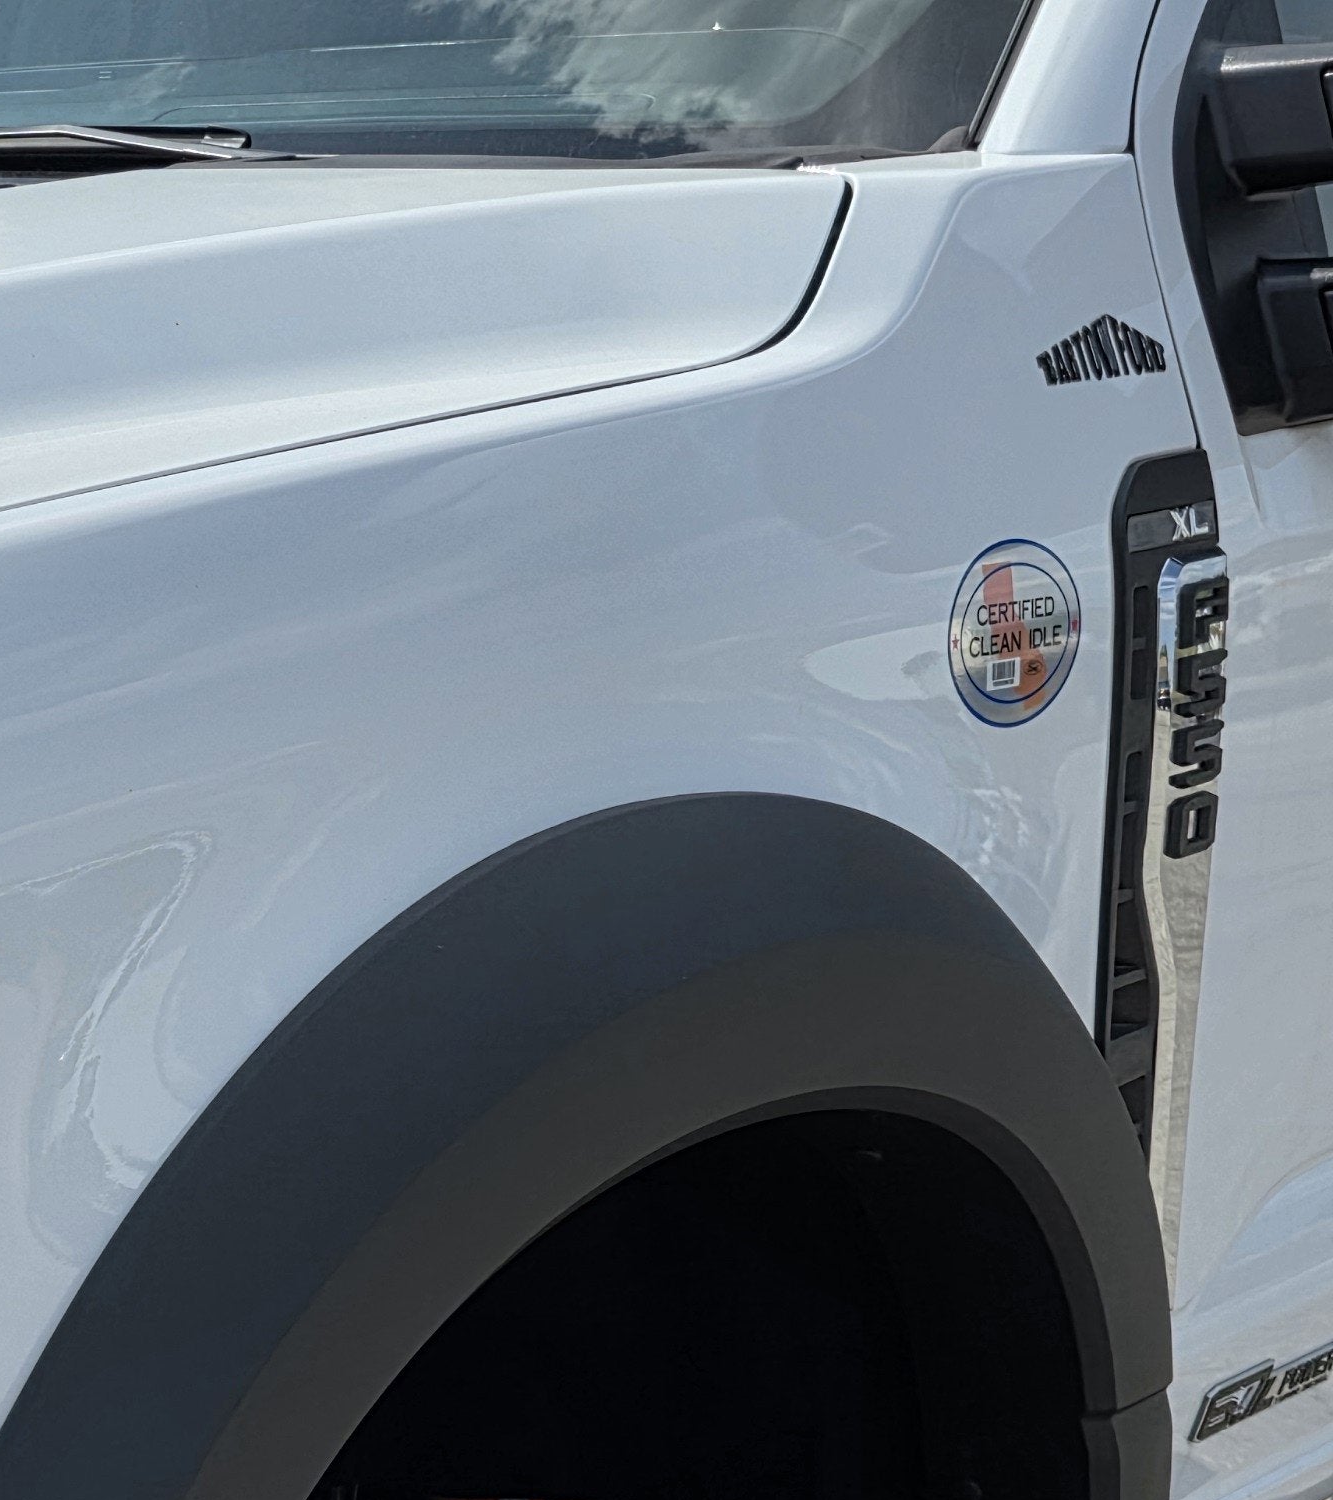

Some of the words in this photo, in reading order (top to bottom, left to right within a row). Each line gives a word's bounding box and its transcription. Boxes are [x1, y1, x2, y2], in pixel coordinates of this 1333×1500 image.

[1106, 314, 1166, 376] FORD
[1169, 506, 1209, 541] XL
[976, 595, 1056, 627] CERTIFIED
[968, 630, 1023, 658] CLEAN
[1028, 623, 1063, 650] IDLE
[1163, 574, 1230, 860] F550
